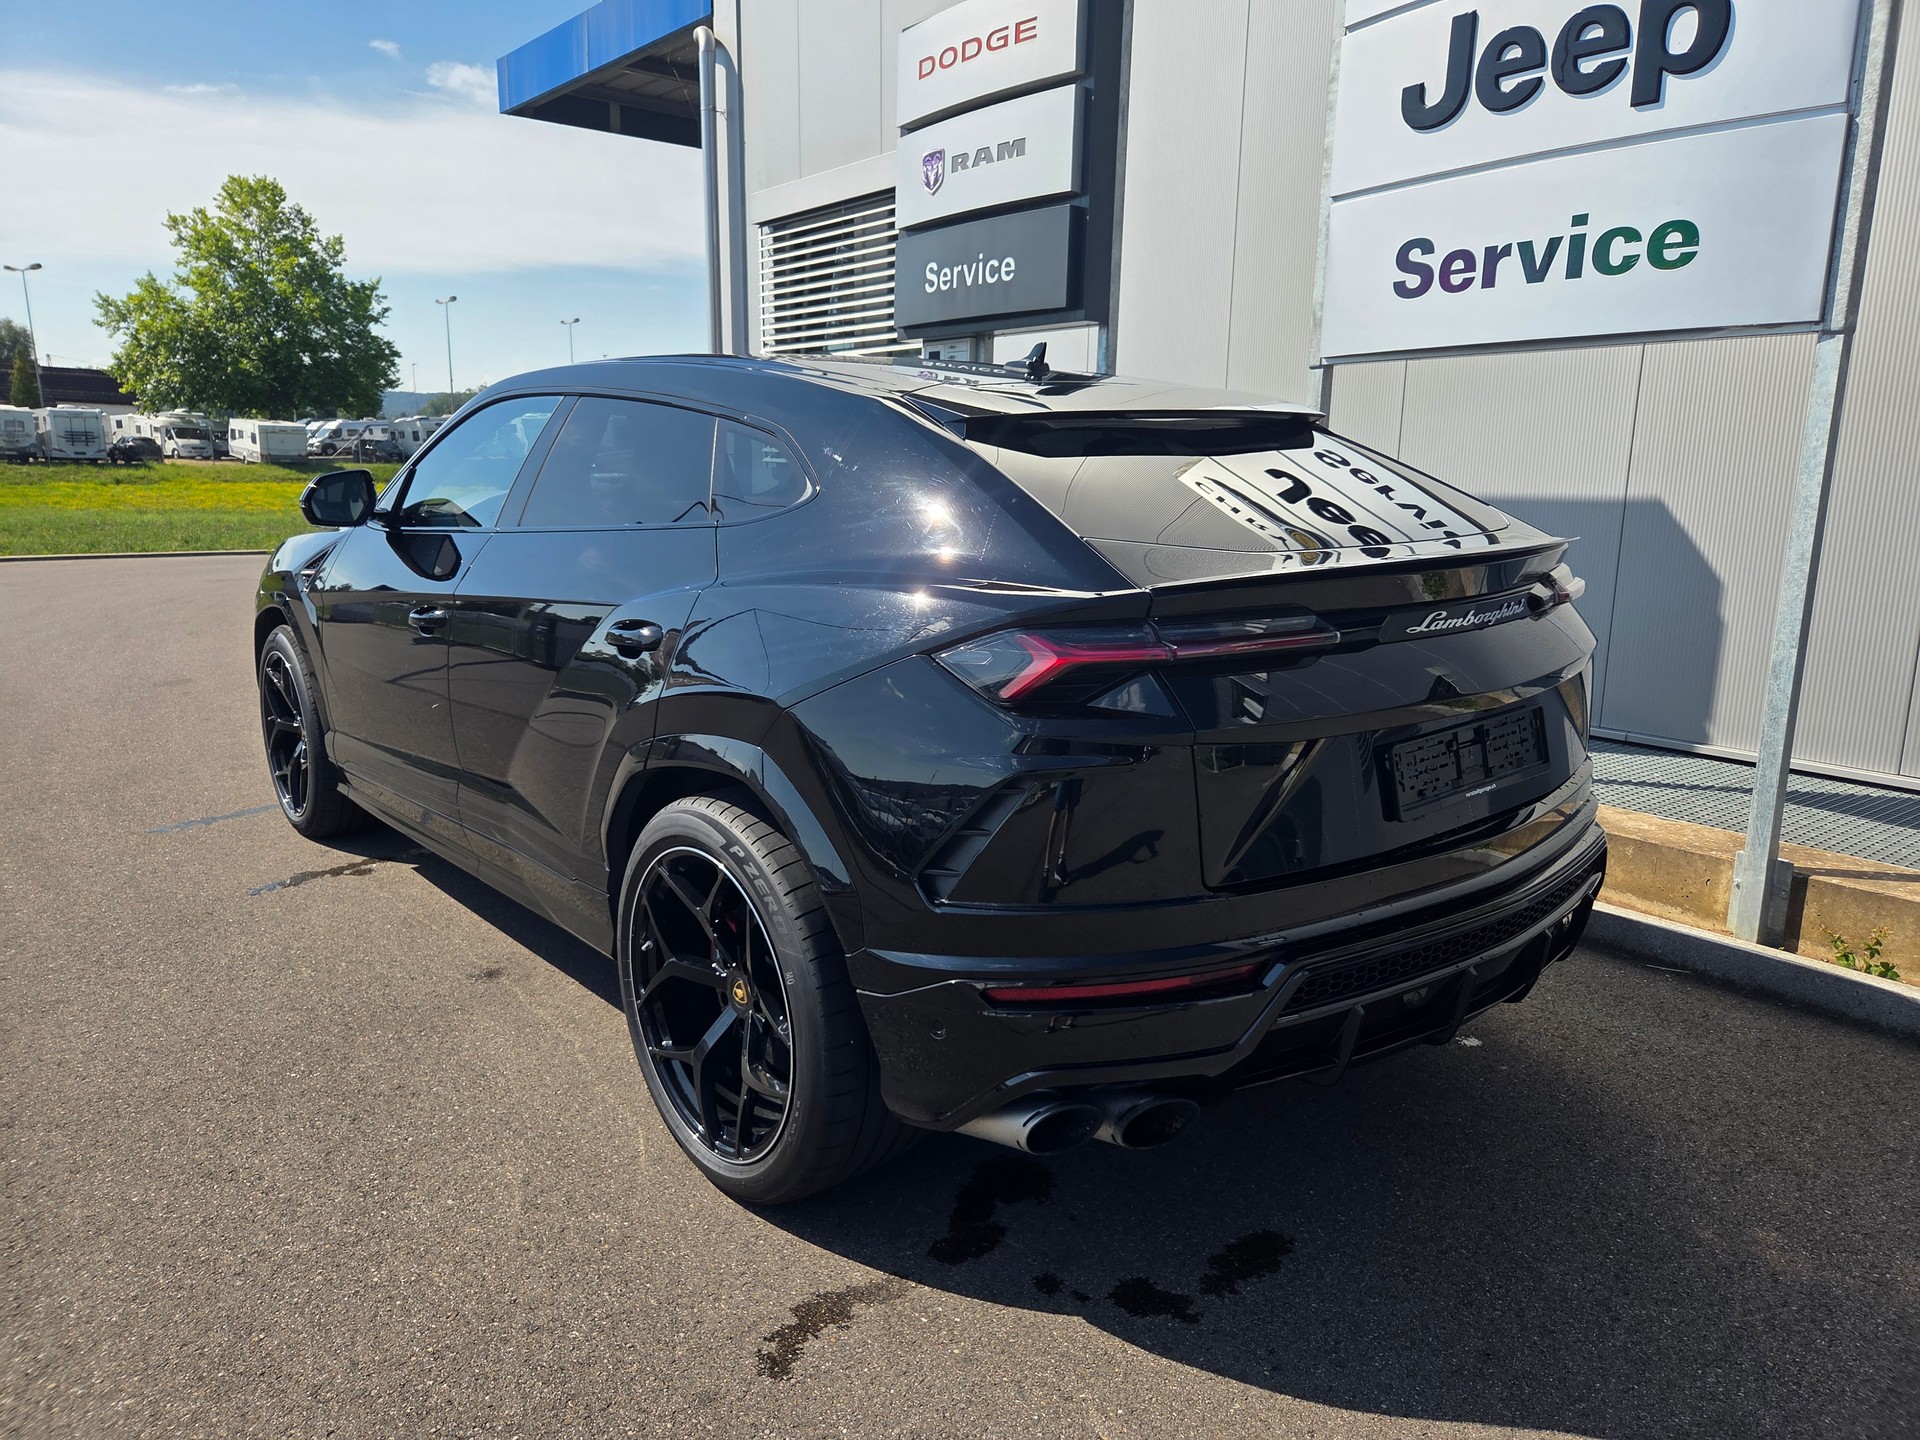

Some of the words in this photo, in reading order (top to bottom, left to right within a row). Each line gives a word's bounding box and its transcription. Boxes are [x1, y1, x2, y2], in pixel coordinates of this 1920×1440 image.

[919, 16, 1038, 80] DODGE
[1400, 0, 1732, 131] Jeep
[951, 137, 1026, 174] RAM
[924, 253, 1015, 294] Service
[1393, 213, 1700, 299] Service
[1405, 599, 1525, 633] Lamborghini
[729, 845, 745, 858] P
[743, 862, 788, 935] ZERO
